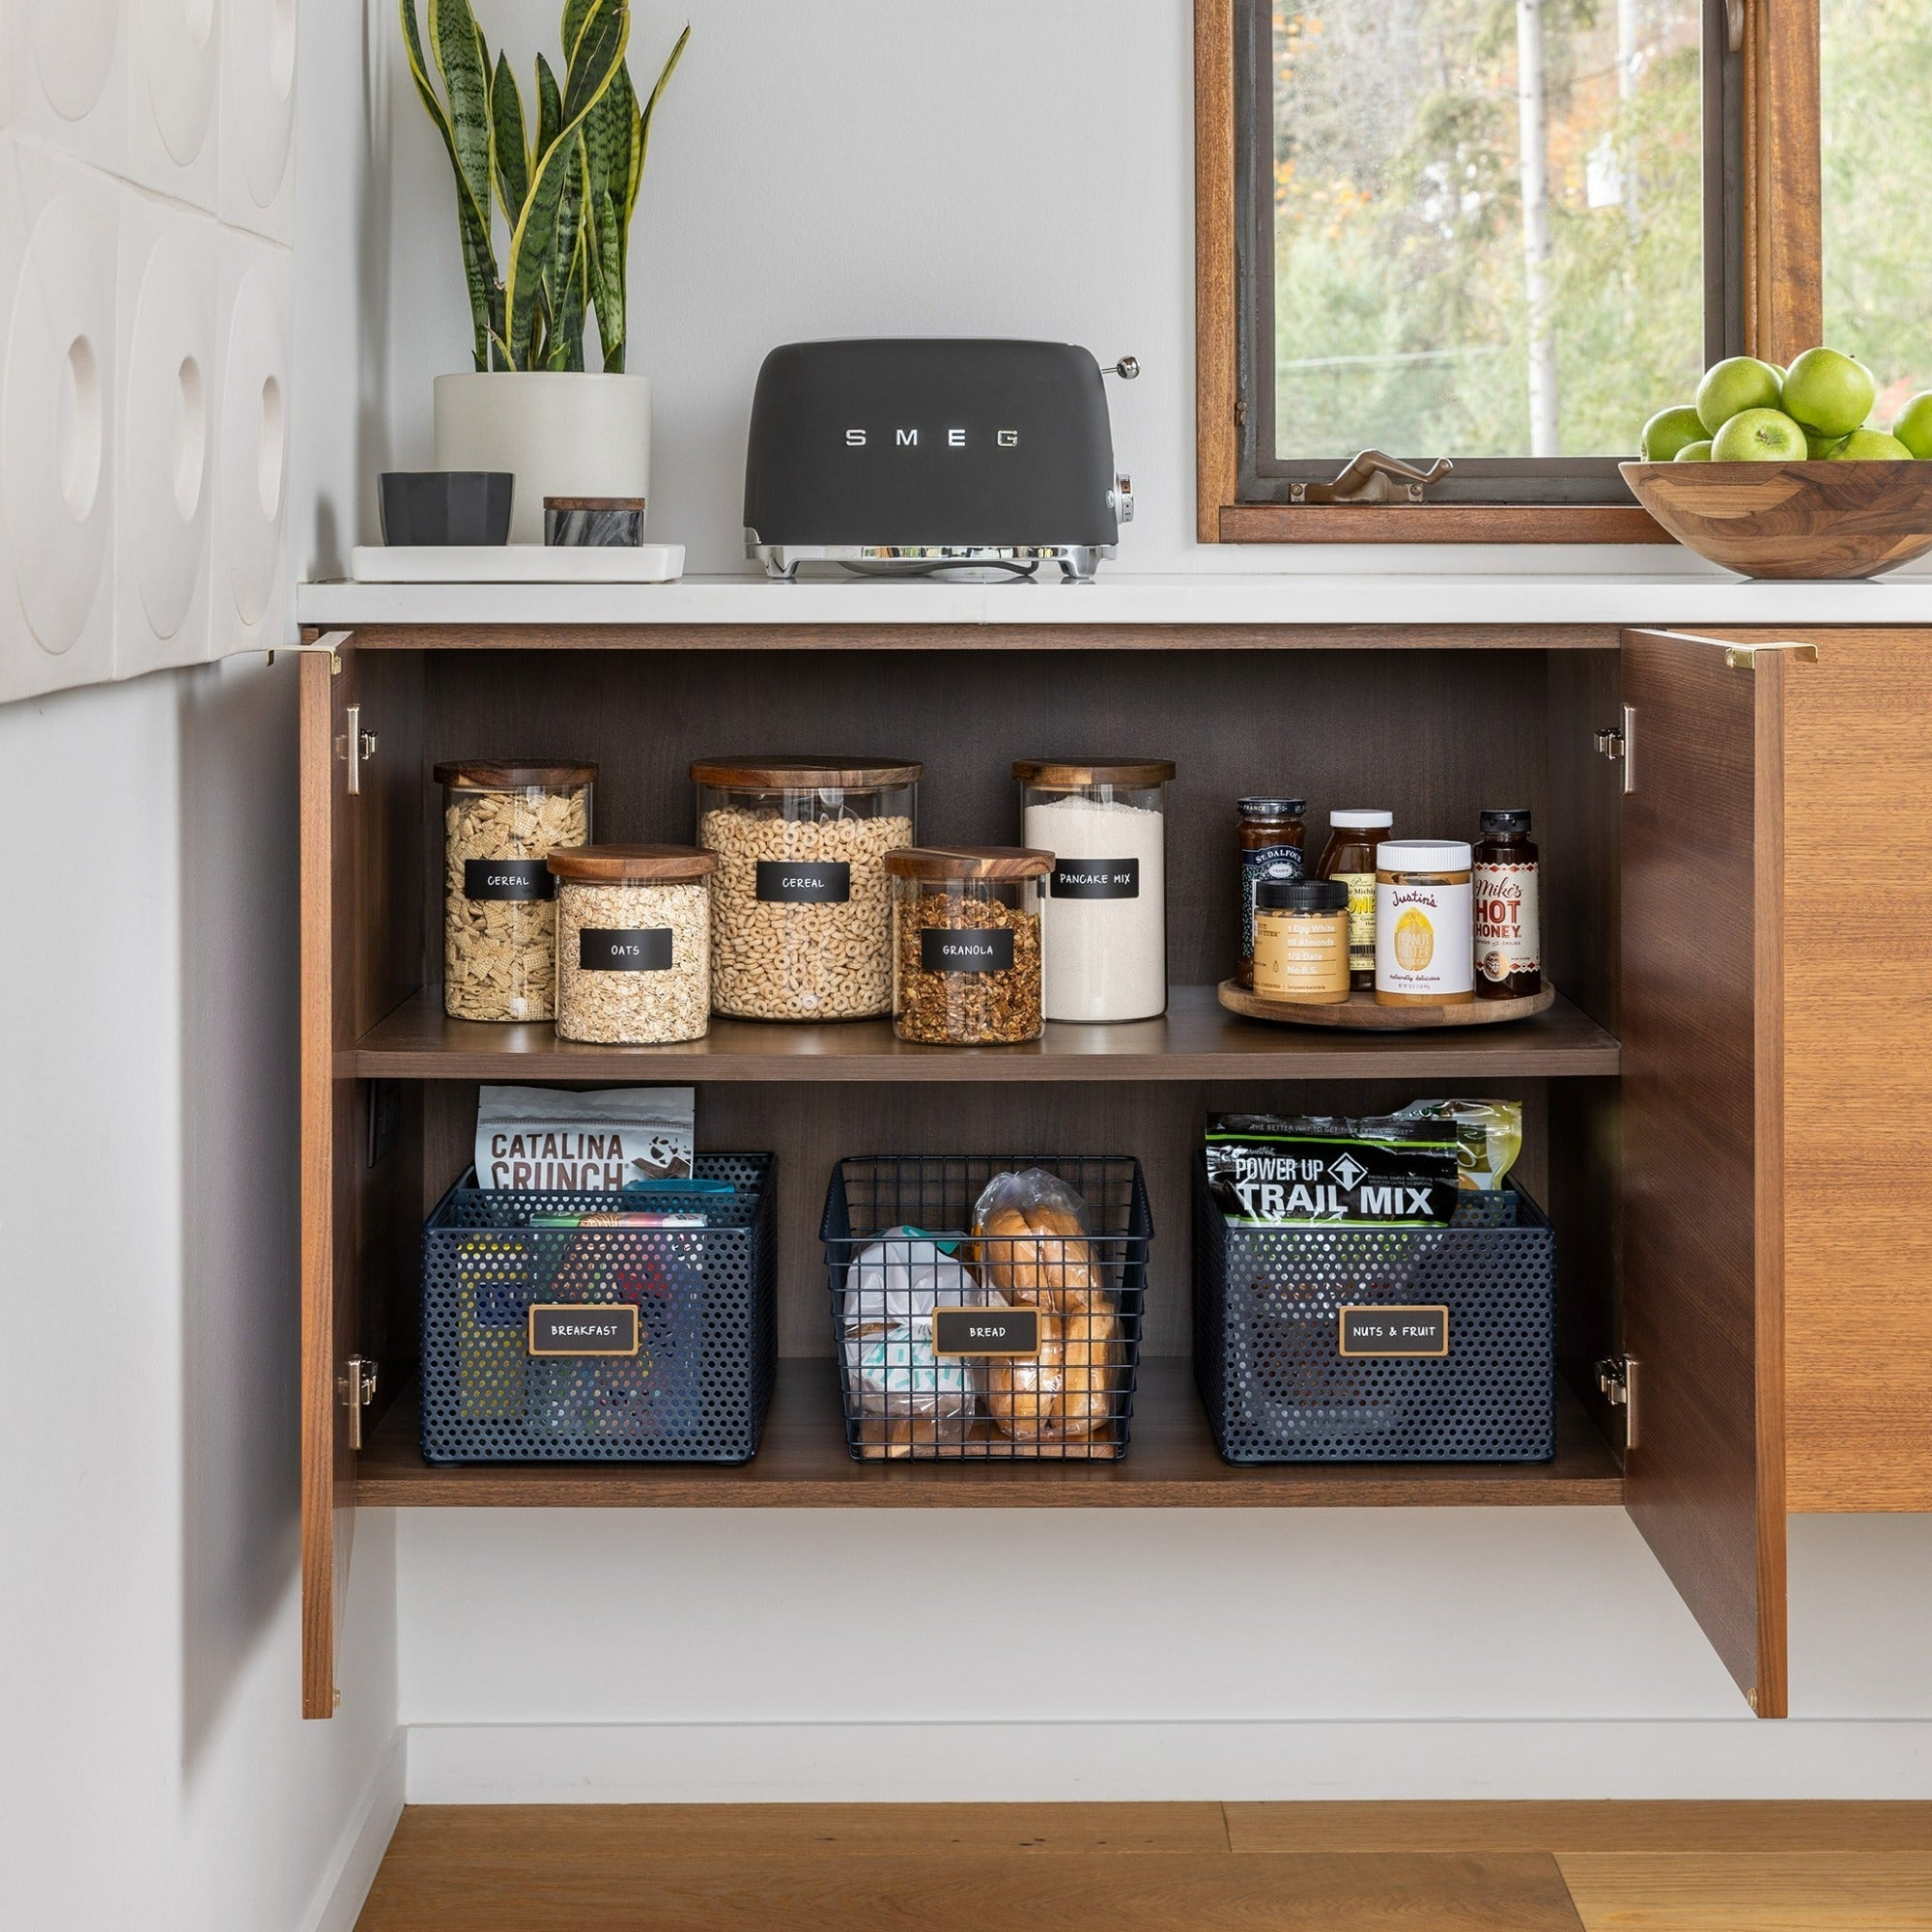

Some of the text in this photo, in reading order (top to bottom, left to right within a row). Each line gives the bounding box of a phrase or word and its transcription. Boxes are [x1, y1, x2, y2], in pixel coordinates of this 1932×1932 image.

[846, 429, 1018, 446] SMEG
[487, 875, 529, 886] CEREAL
[781, 878, 824, 888] CEREAL
[1060, 873, 1130, 884] PANCAKE MIX
[1476, 876, 1522, 898] Mike's
[1392, 890, 1437, 908] Justin's
[1476, 899, 1520, 923] HOT
[1293, 924, 1309, 935] Egg
[1398, 933, 1430, 945] PEANUT
[611, 945, 639, 955] OATS
[942, 945, 993, 955] GRANOLA
[1288, 952, 1299, 960] 1/2
[1287, 965, 1299, 974] No
[491, 1132, 624, 1160] CATALINA
[1236, 1157, 1323, 1181] POWER UP
[491, 1160, 624, 1191] CRUNCH
[1236, 1183, 1434, 1215] TRAIL MIX
[551, 1325, 617, 1335] BREAKFAST
[969, 1327, 1006, 1337] BREAD
[1352, 1326, 1435, 1336] NUTS & FRUIT
